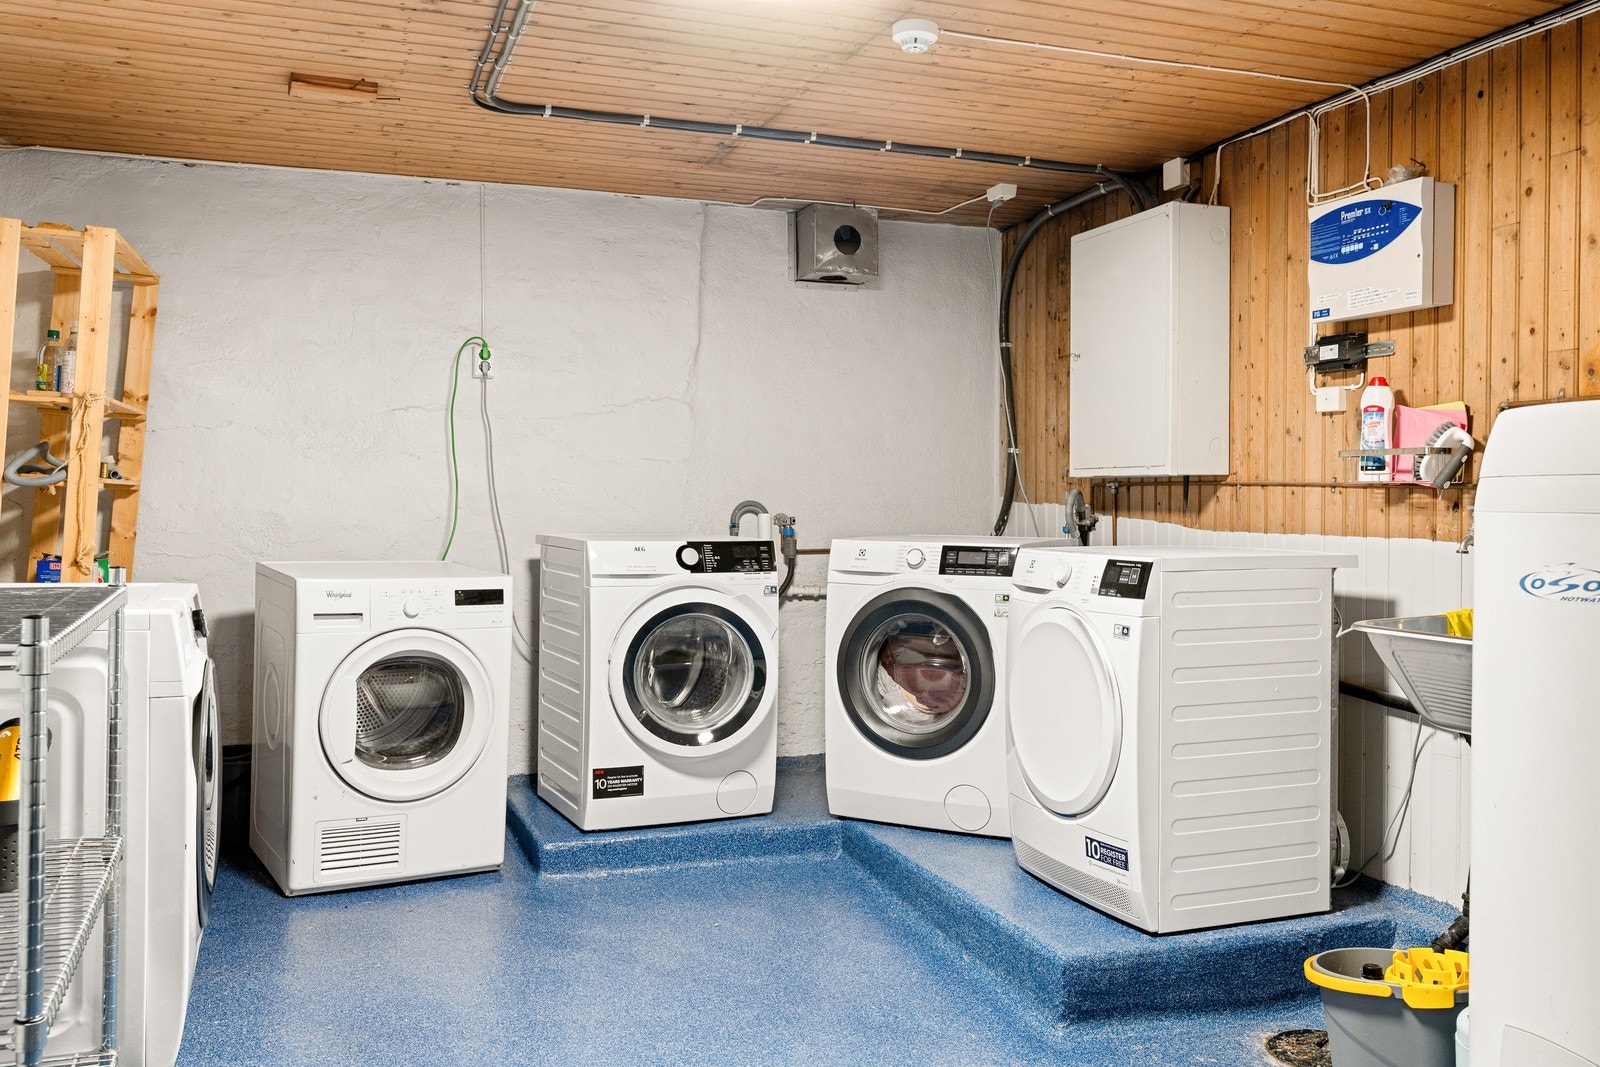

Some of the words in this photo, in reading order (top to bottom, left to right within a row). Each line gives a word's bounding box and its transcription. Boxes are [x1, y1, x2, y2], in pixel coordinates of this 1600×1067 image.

[1341, 208, 1363, 220] Premier
[326, 591, 351, 600] Whirlpool
[594, 778, 607, 790] 10
[1086, 838, 1101, 860] 10
[1100, 847, 1126, 862] REGISTER
[1100, 854, 1112, 864] FOR
[1112, 858, 1126, 870] FREE
